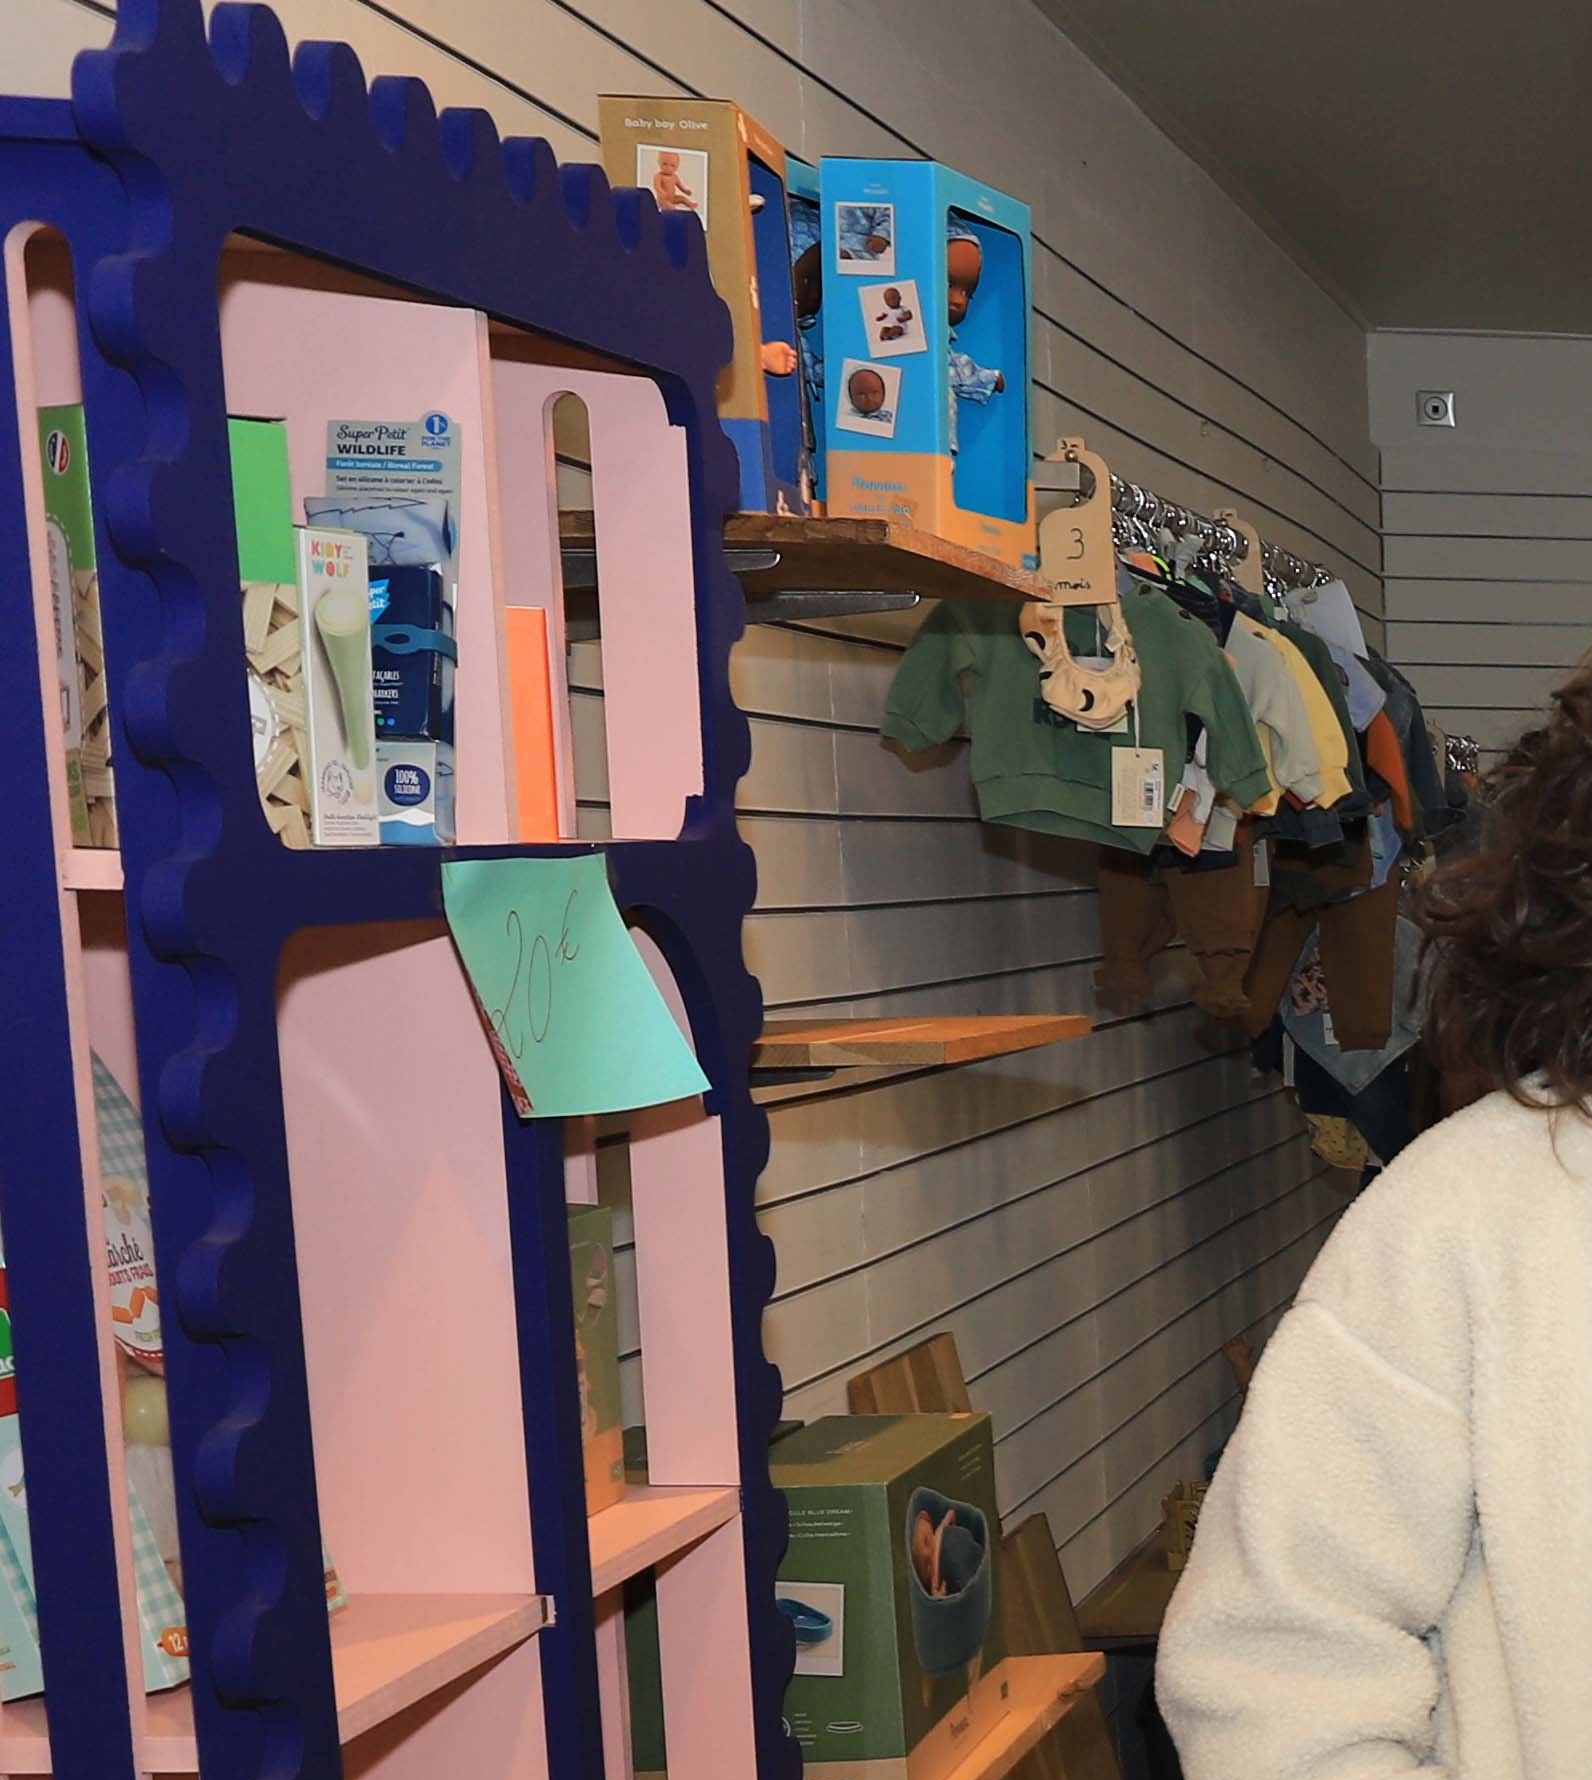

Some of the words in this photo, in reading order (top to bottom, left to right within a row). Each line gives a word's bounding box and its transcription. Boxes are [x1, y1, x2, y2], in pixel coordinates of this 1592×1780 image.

[624, 118, 652, 129] Baby
[655, 119, 675, 130] boy
[679, 119, 708, 129] Olive
[337, 424, 374, 442] Super
[375, 425, 406, 441] Petit
[336, 444, 406, 455] WILDLIFE
[311, 540, 343, 558] KIDY
[1066, 528, 1085, 560] 3
[312, 560, 351, 577] WOLF
[369, 585, 386, 598] per
[1054, 580, 1092, 590] mois
[395, 769, 419, 785] 100%
[107, 1232, 145, 1268] arché
